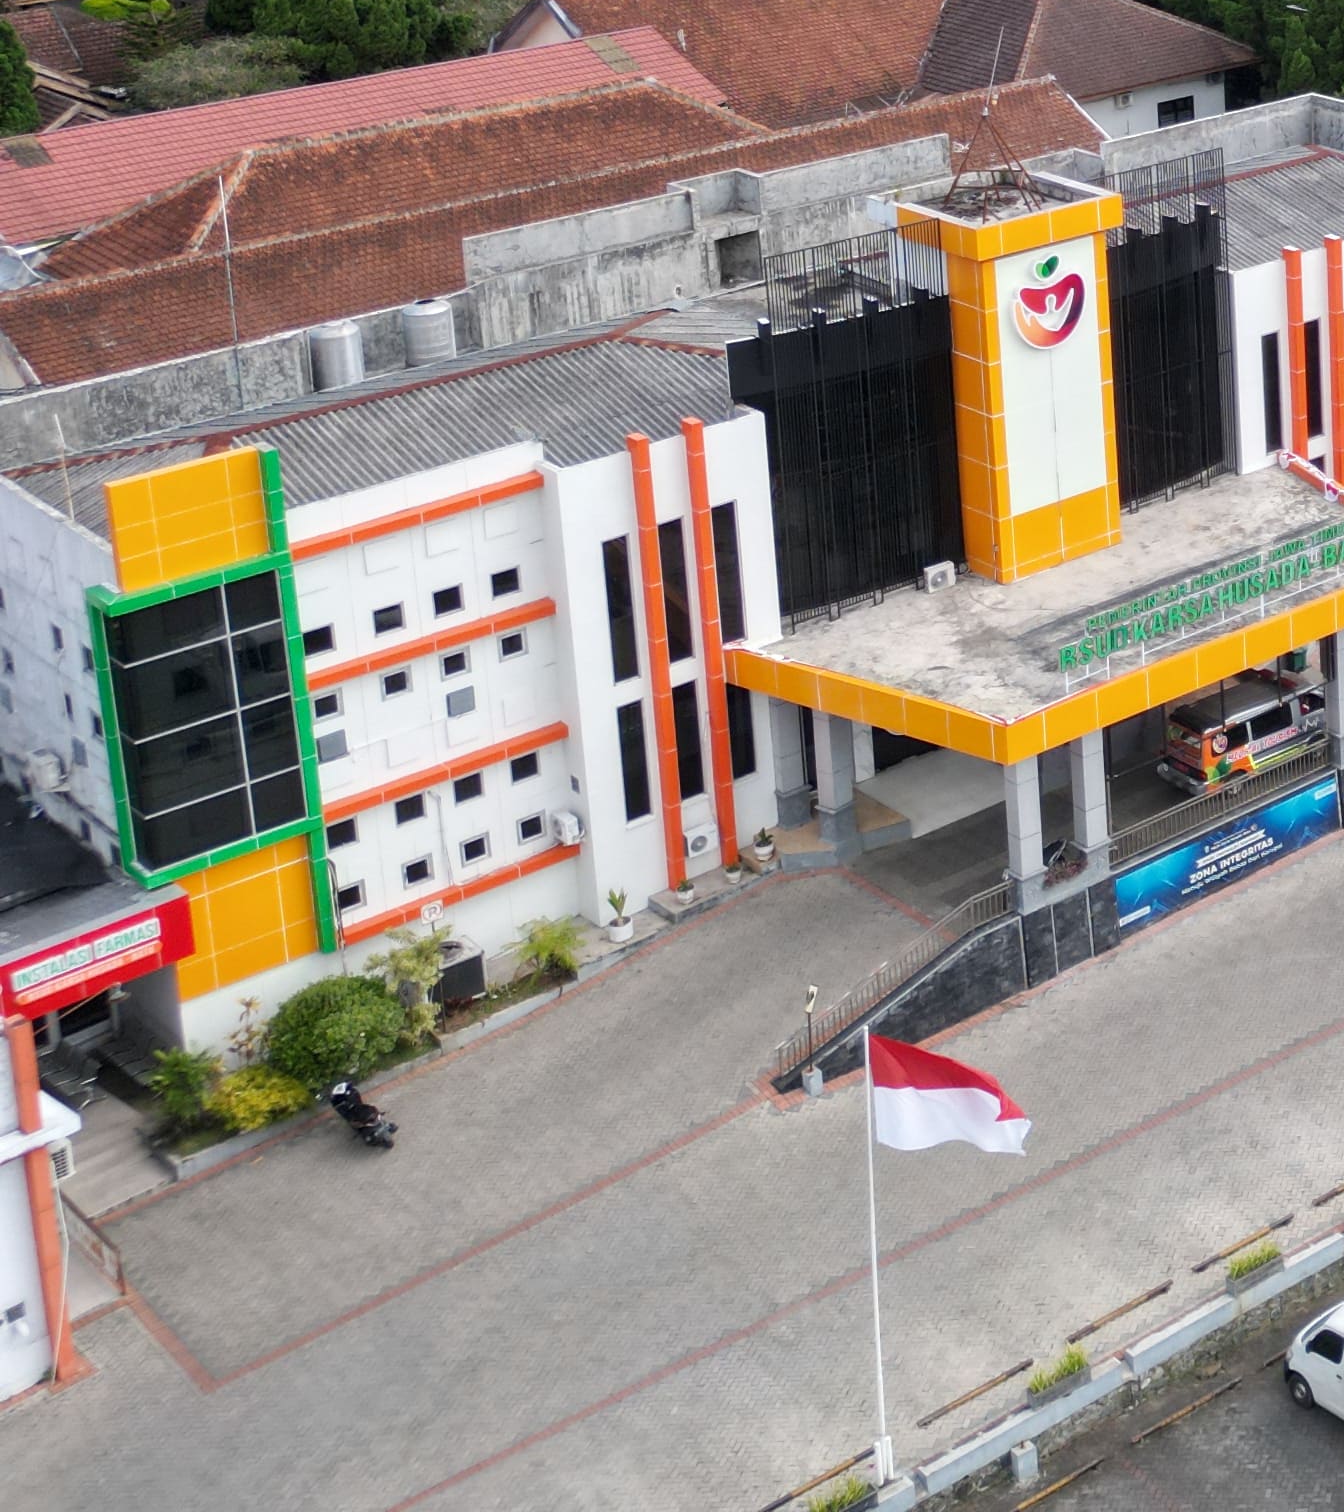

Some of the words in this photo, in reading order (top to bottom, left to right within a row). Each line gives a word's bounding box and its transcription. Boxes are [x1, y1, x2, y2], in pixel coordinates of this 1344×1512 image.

[1268, 539, 1305, 562] JAWA
[1058, 625, 1130, 673] RSUD
[1132, 594, 1214, 642] KARSA
[1189, 864, 1217, 884] ZONA
[1219, 836, 1274, 870] INTEGRITAS
[15, 947, 90, 988] INSTALASI
[97, 921, 158, 954] FARMASI
